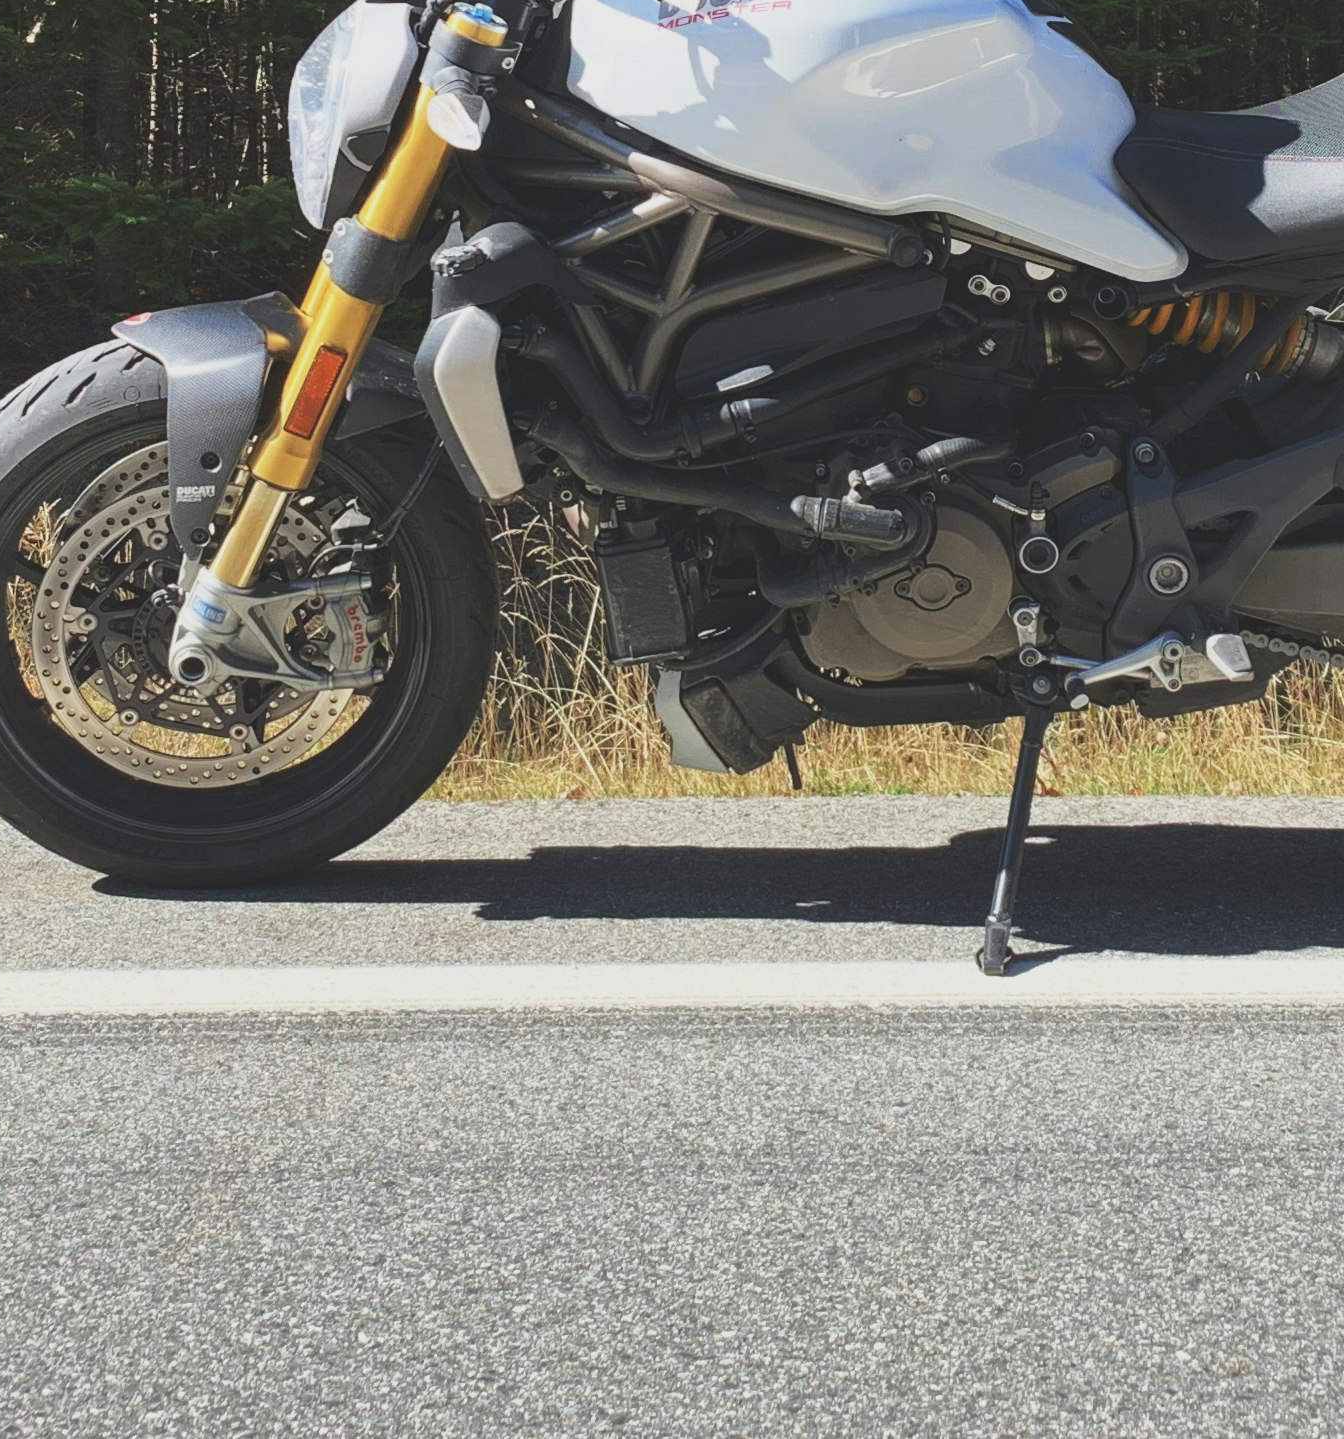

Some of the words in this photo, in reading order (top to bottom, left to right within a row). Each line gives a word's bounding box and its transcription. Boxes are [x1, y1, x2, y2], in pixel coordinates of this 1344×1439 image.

[657, 0, 793, 30] MONSTER
[176, 485, 216, 495] DUCATI
[347, 604, 367, 663] brembo
